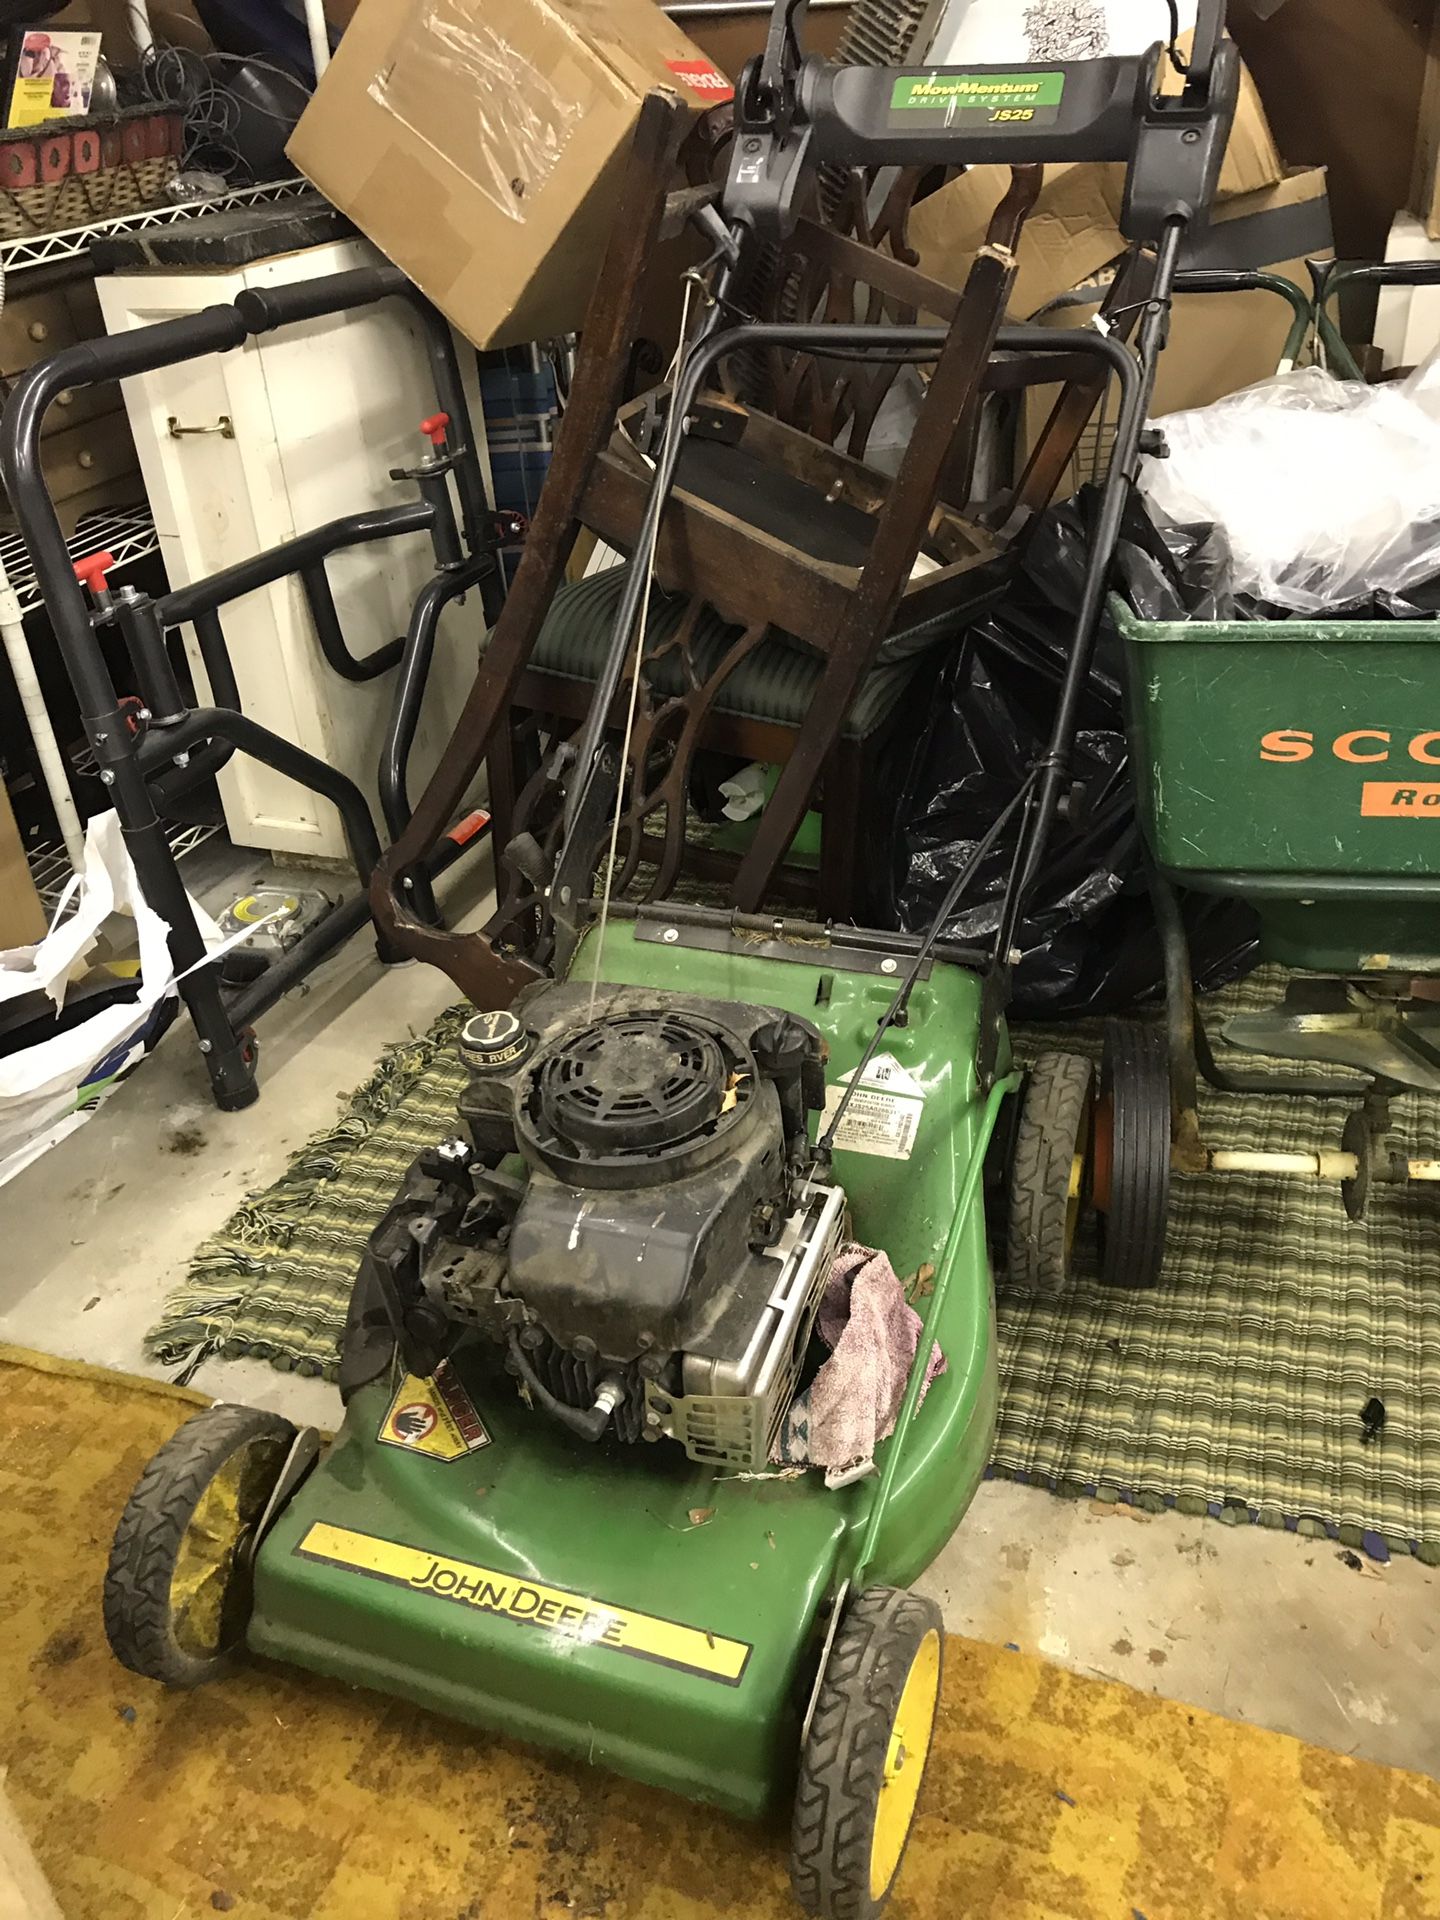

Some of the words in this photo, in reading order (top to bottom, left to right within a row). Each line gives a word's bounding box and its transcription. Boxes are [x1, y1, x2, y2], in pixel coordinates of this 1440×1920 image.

[911, 82, 1040, 96] MowMentum
[908, 95, 956, 105] DRIV
[967, 94, 1037, 104] SYSTEM
[988, 108, 1034, 122] JS25
[410, 1561, 507, 1606] JOHN
